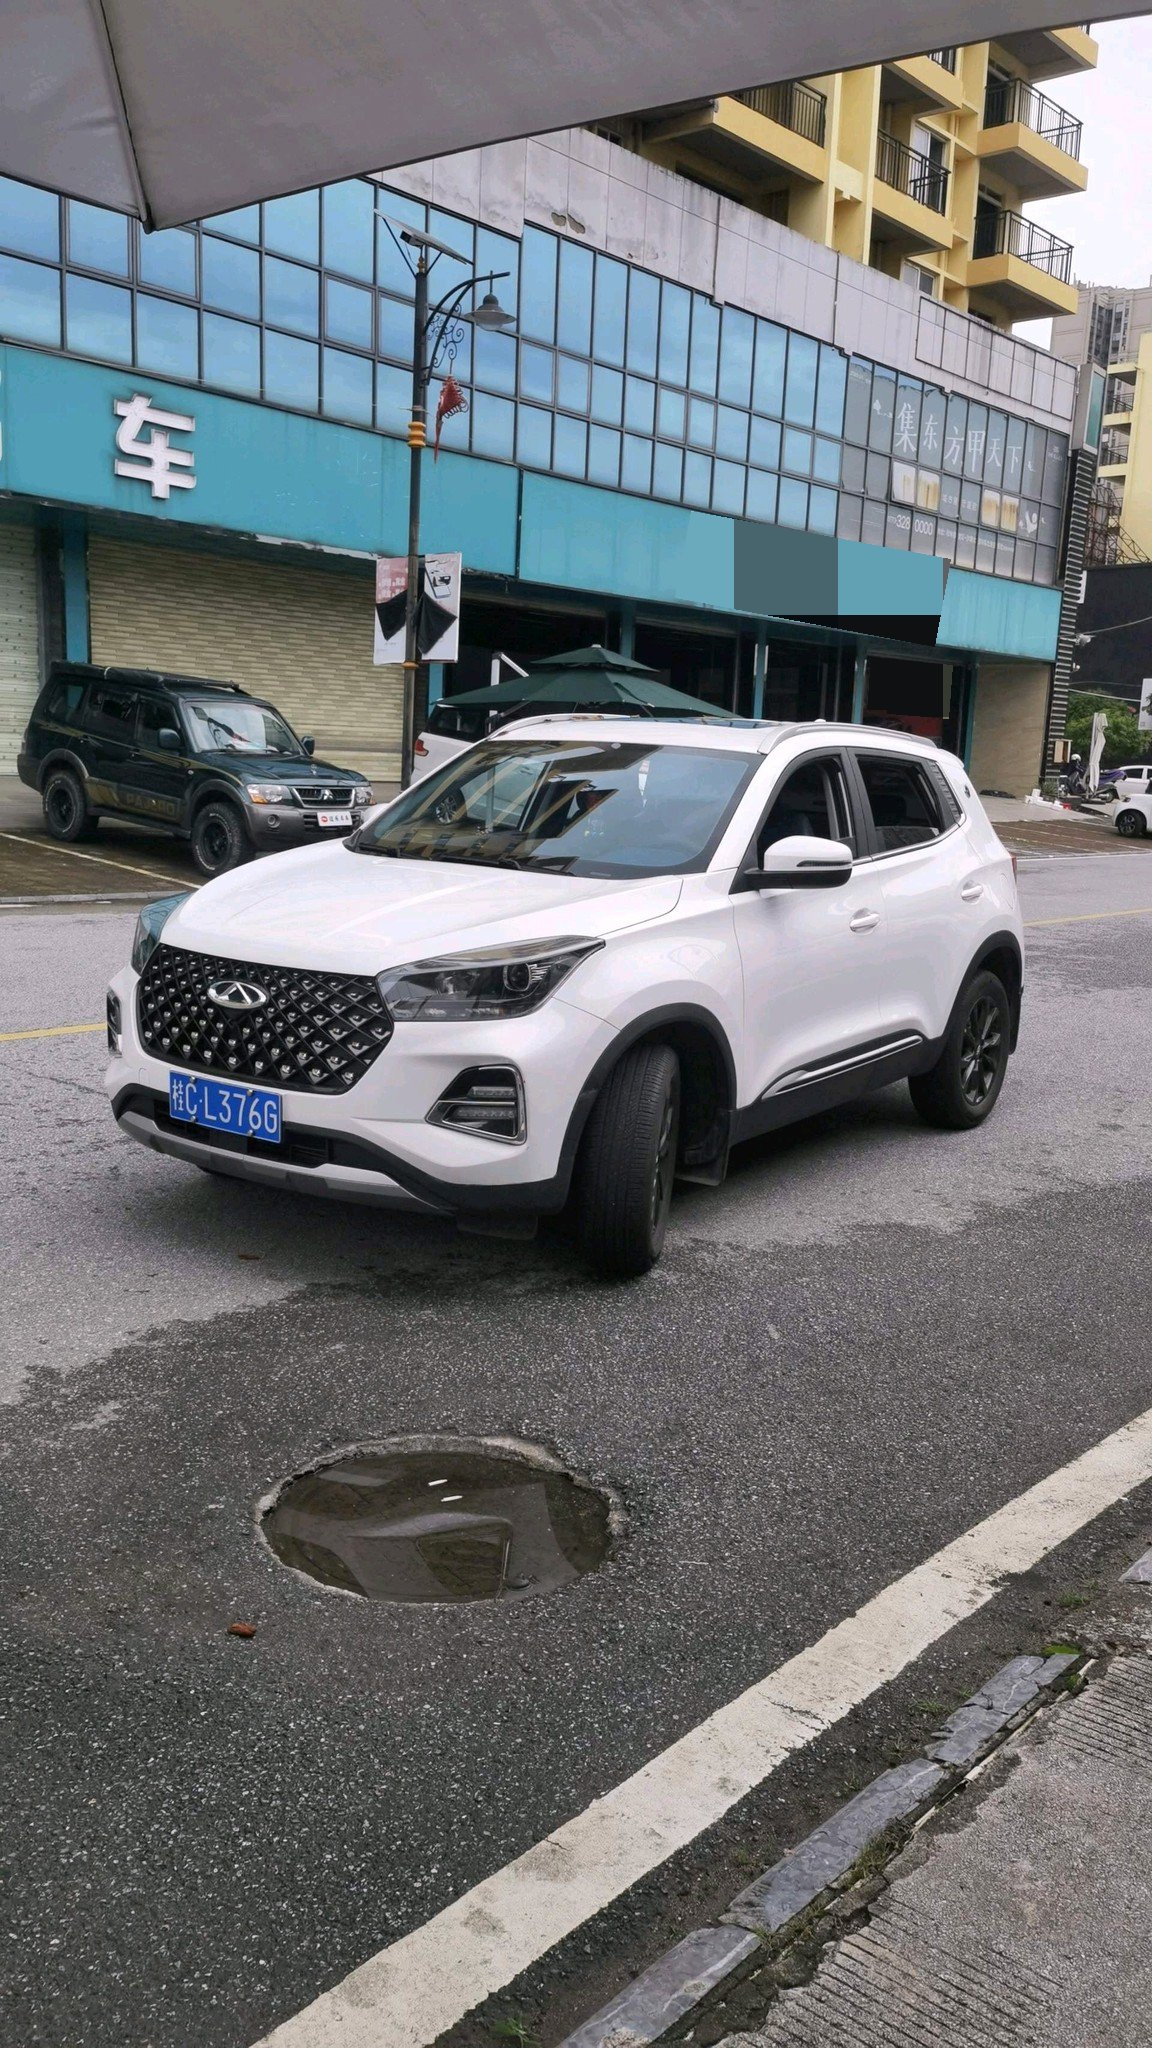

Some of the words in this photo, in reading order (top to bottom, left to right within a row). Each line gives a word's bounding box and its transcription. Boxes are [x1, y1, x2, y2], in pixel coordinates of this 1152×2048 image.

[114, 393, 196, 499] 车
[895, 402, 1022, 474] 集东方甲天下
